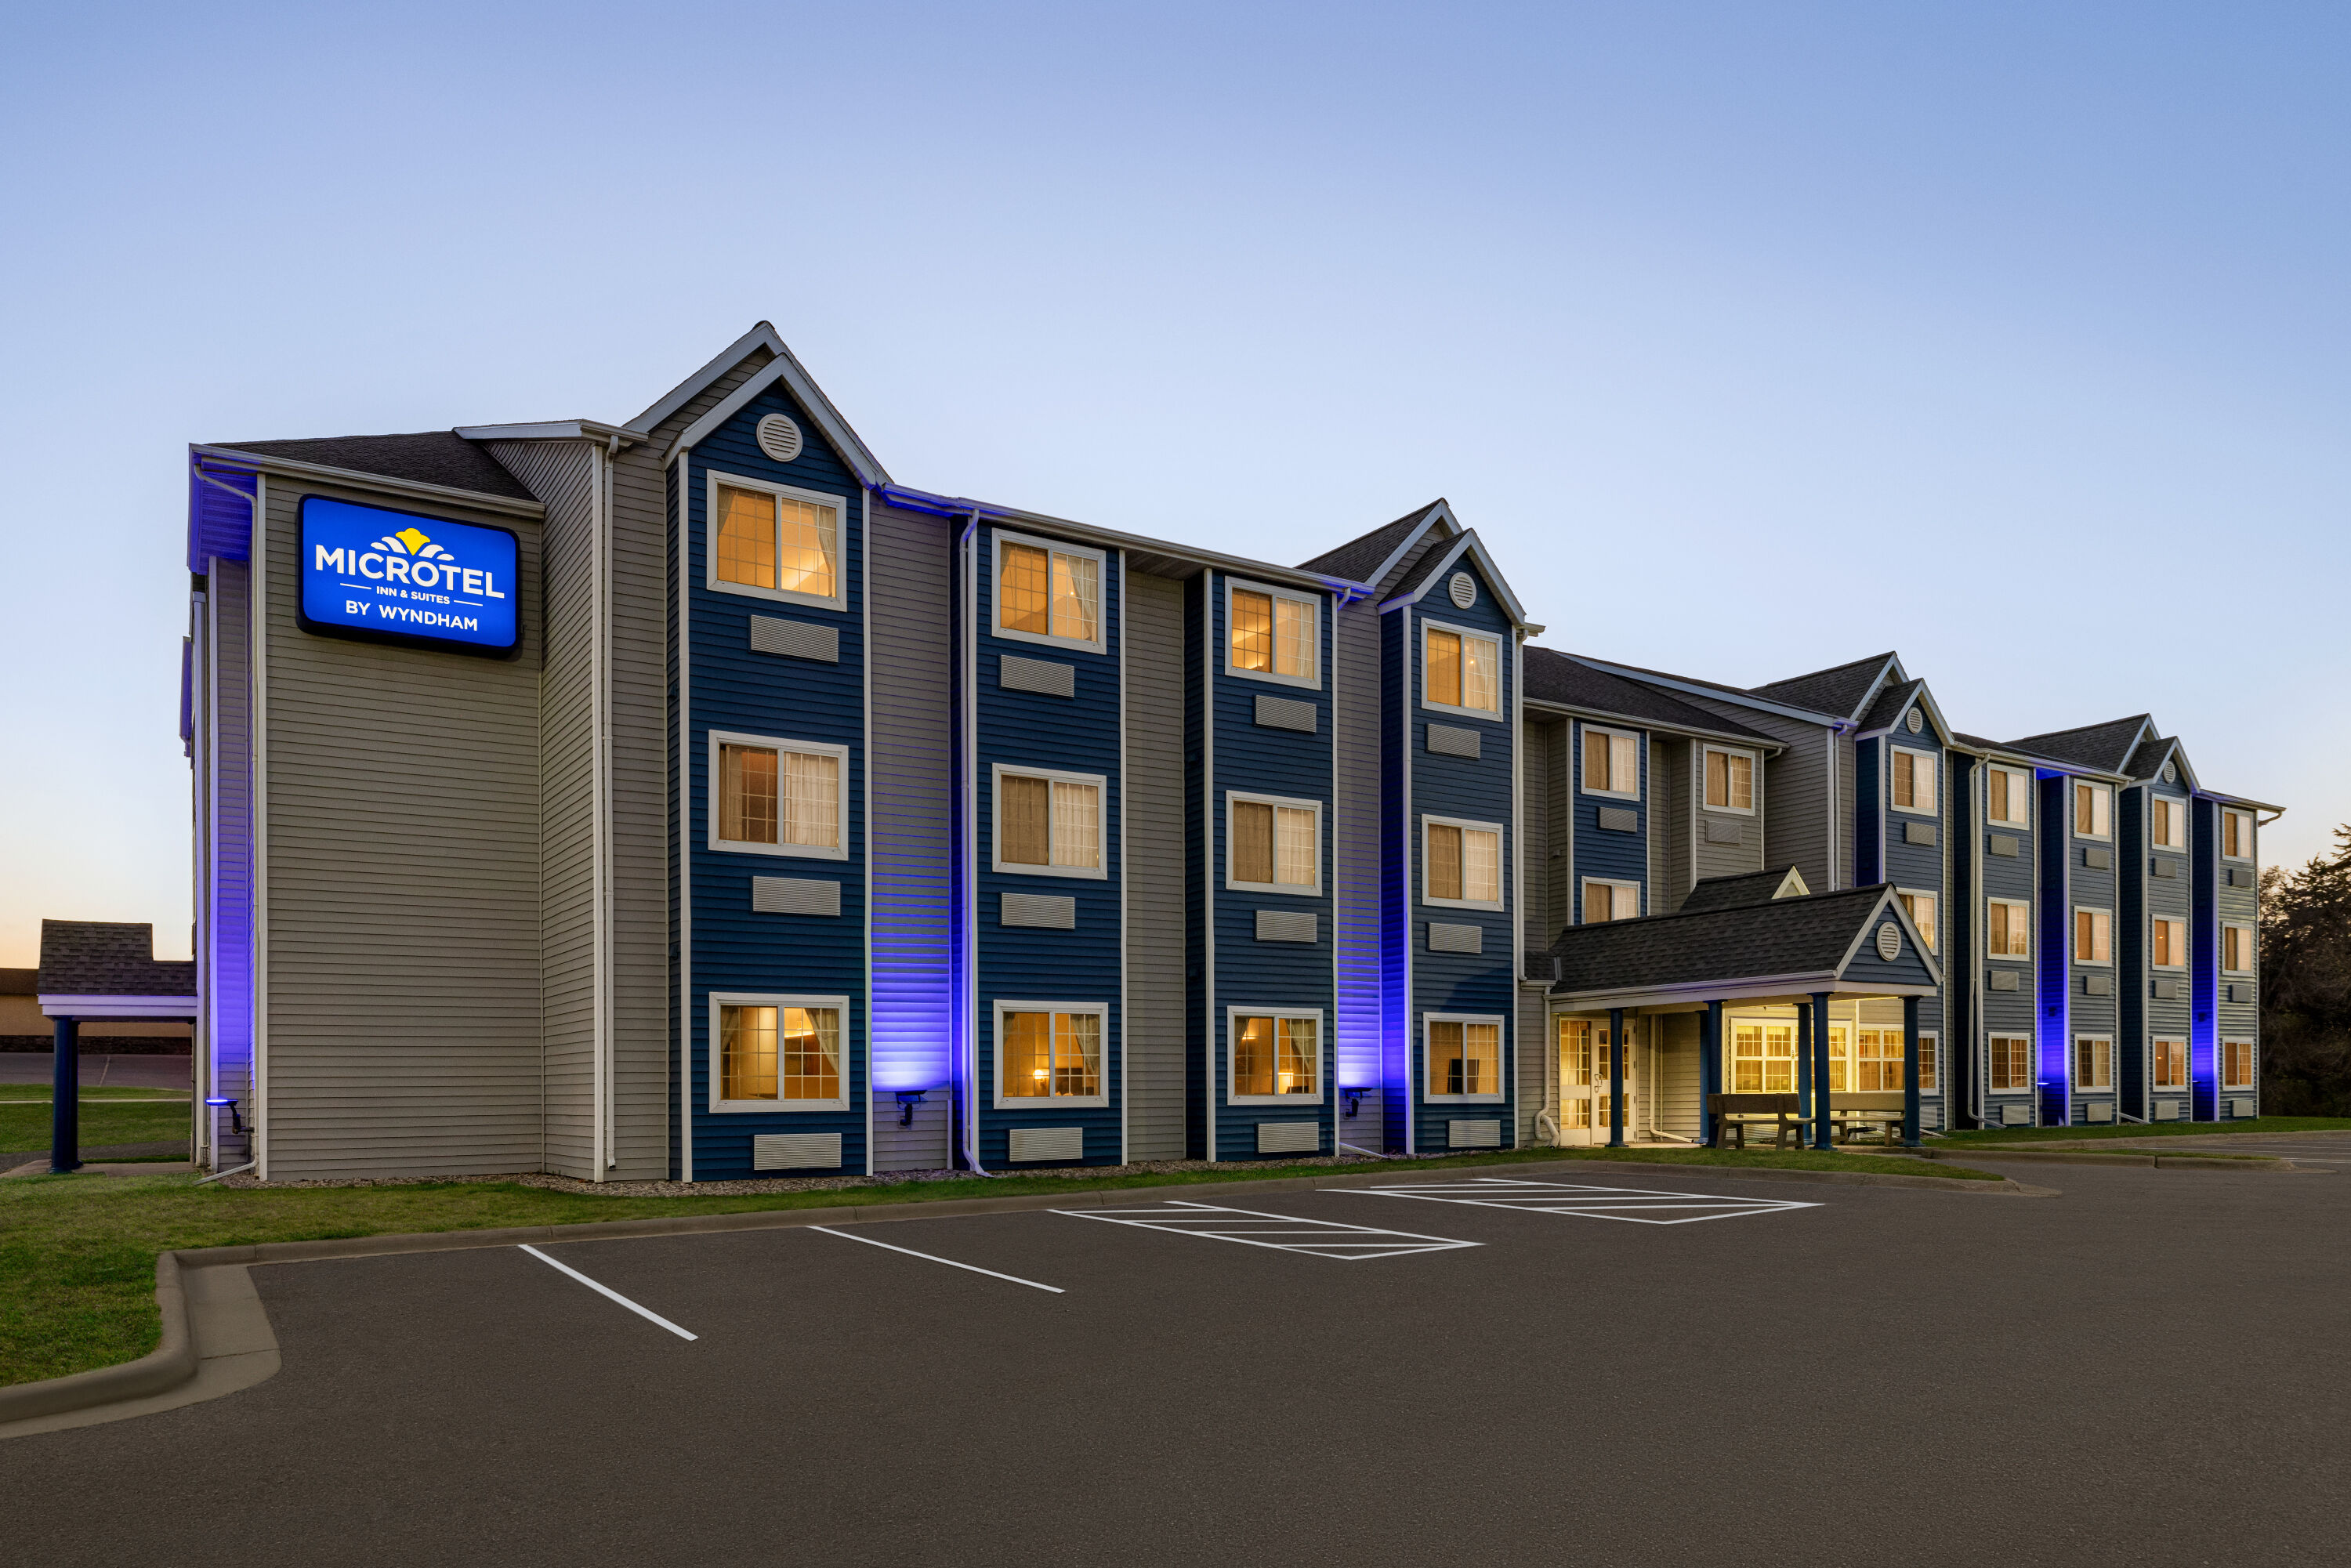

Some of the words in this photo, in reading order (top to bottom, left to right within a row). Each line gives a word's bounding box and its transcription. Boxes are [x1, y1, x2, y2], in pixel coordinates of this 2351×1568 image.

[316, 545, 505, 599] MICROTEL
[376, 585, 397, 597] INN
[400, 589, 408, 599] &
[411, 592, 450, 605] SUITES
[346, 600, 371, 616] BY
[379, 605, 478, 632] WYNDHAM
